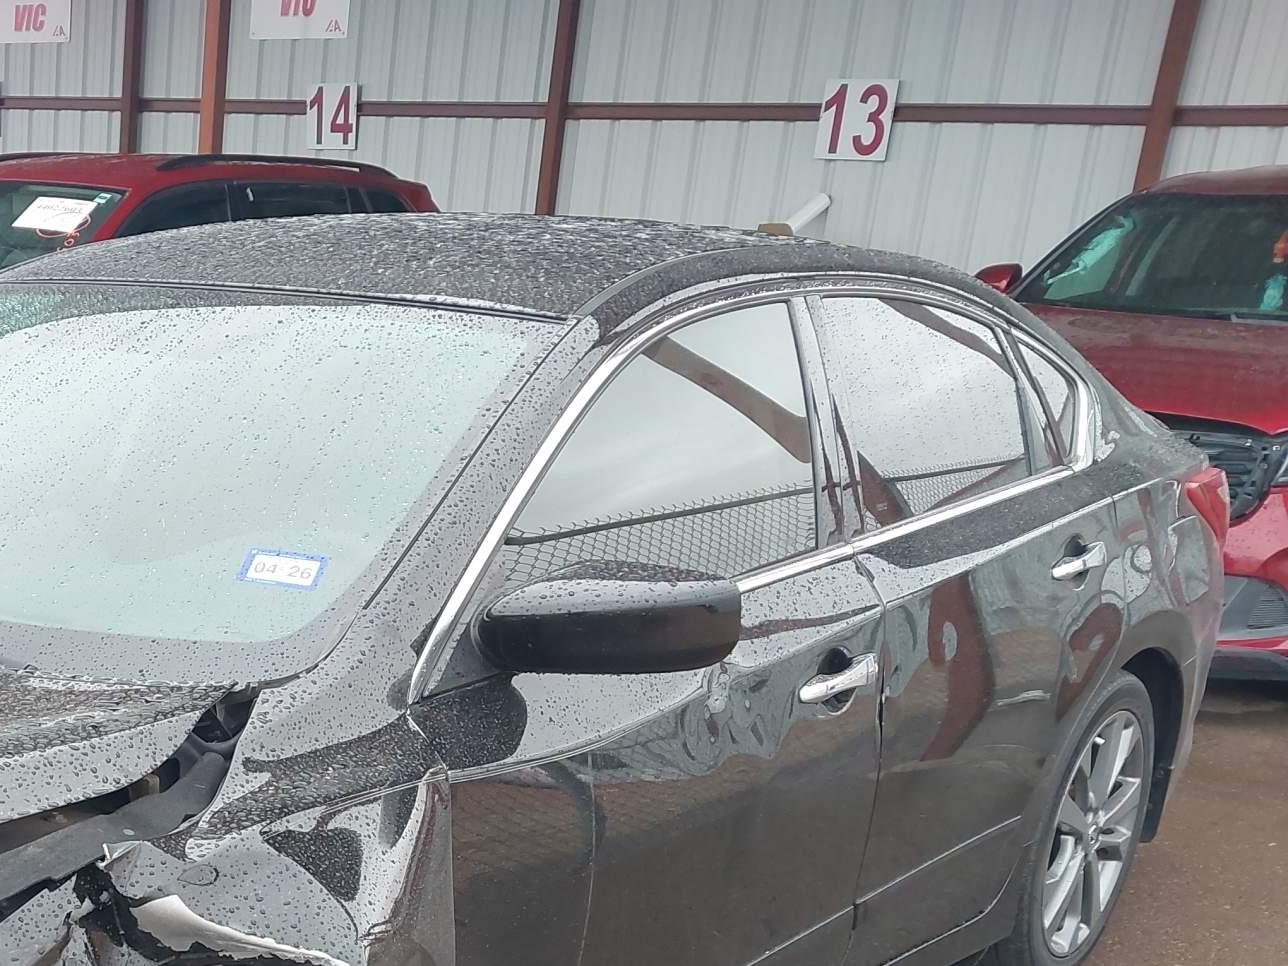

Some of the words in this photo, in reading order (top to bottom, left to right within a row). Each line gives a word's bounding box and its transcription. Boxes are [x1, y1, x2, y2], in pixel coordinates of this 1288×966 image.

[14, 3, 47, 33] VIC
[309, 86, 353, 145] 14
[823, 83, 889, 156] 13
